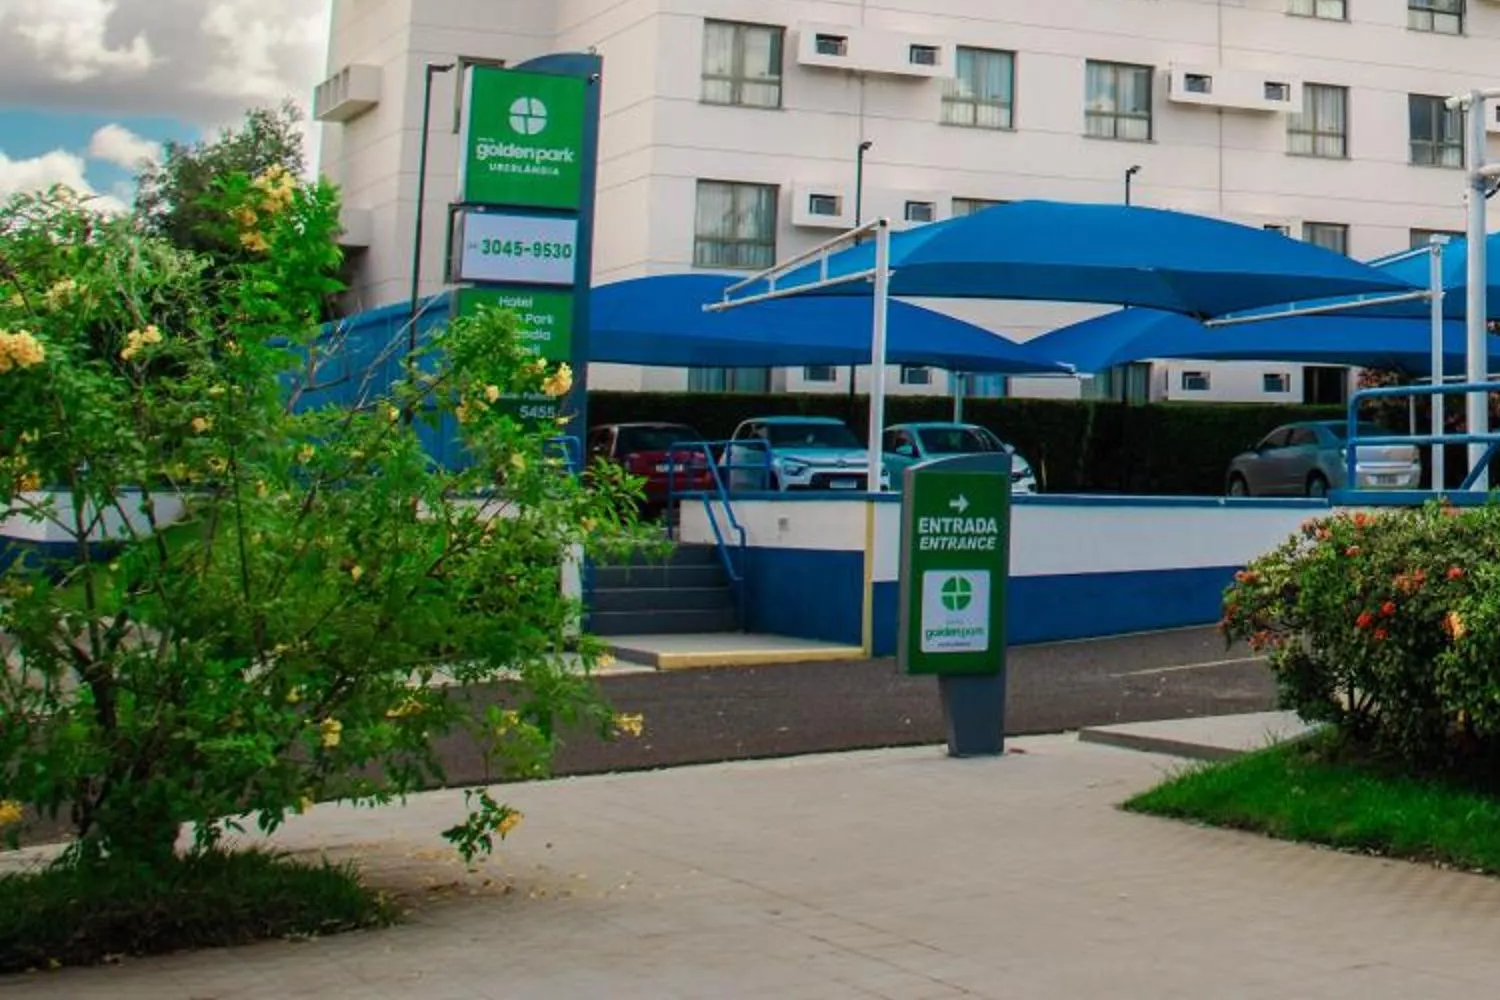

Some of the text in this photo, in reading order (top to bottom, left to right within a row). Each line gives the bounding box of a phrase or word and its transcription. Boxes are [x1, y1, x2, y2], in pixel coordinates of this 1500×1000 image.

[476, 143, 574, 164] goldenpark
[481, 239, 572, 259] 3045-9530
[499, 295, 533, 309] Hotel
[919, 517, 998, 534] ENTRADA
[919, 536, 996, 550] ENTRANCE
